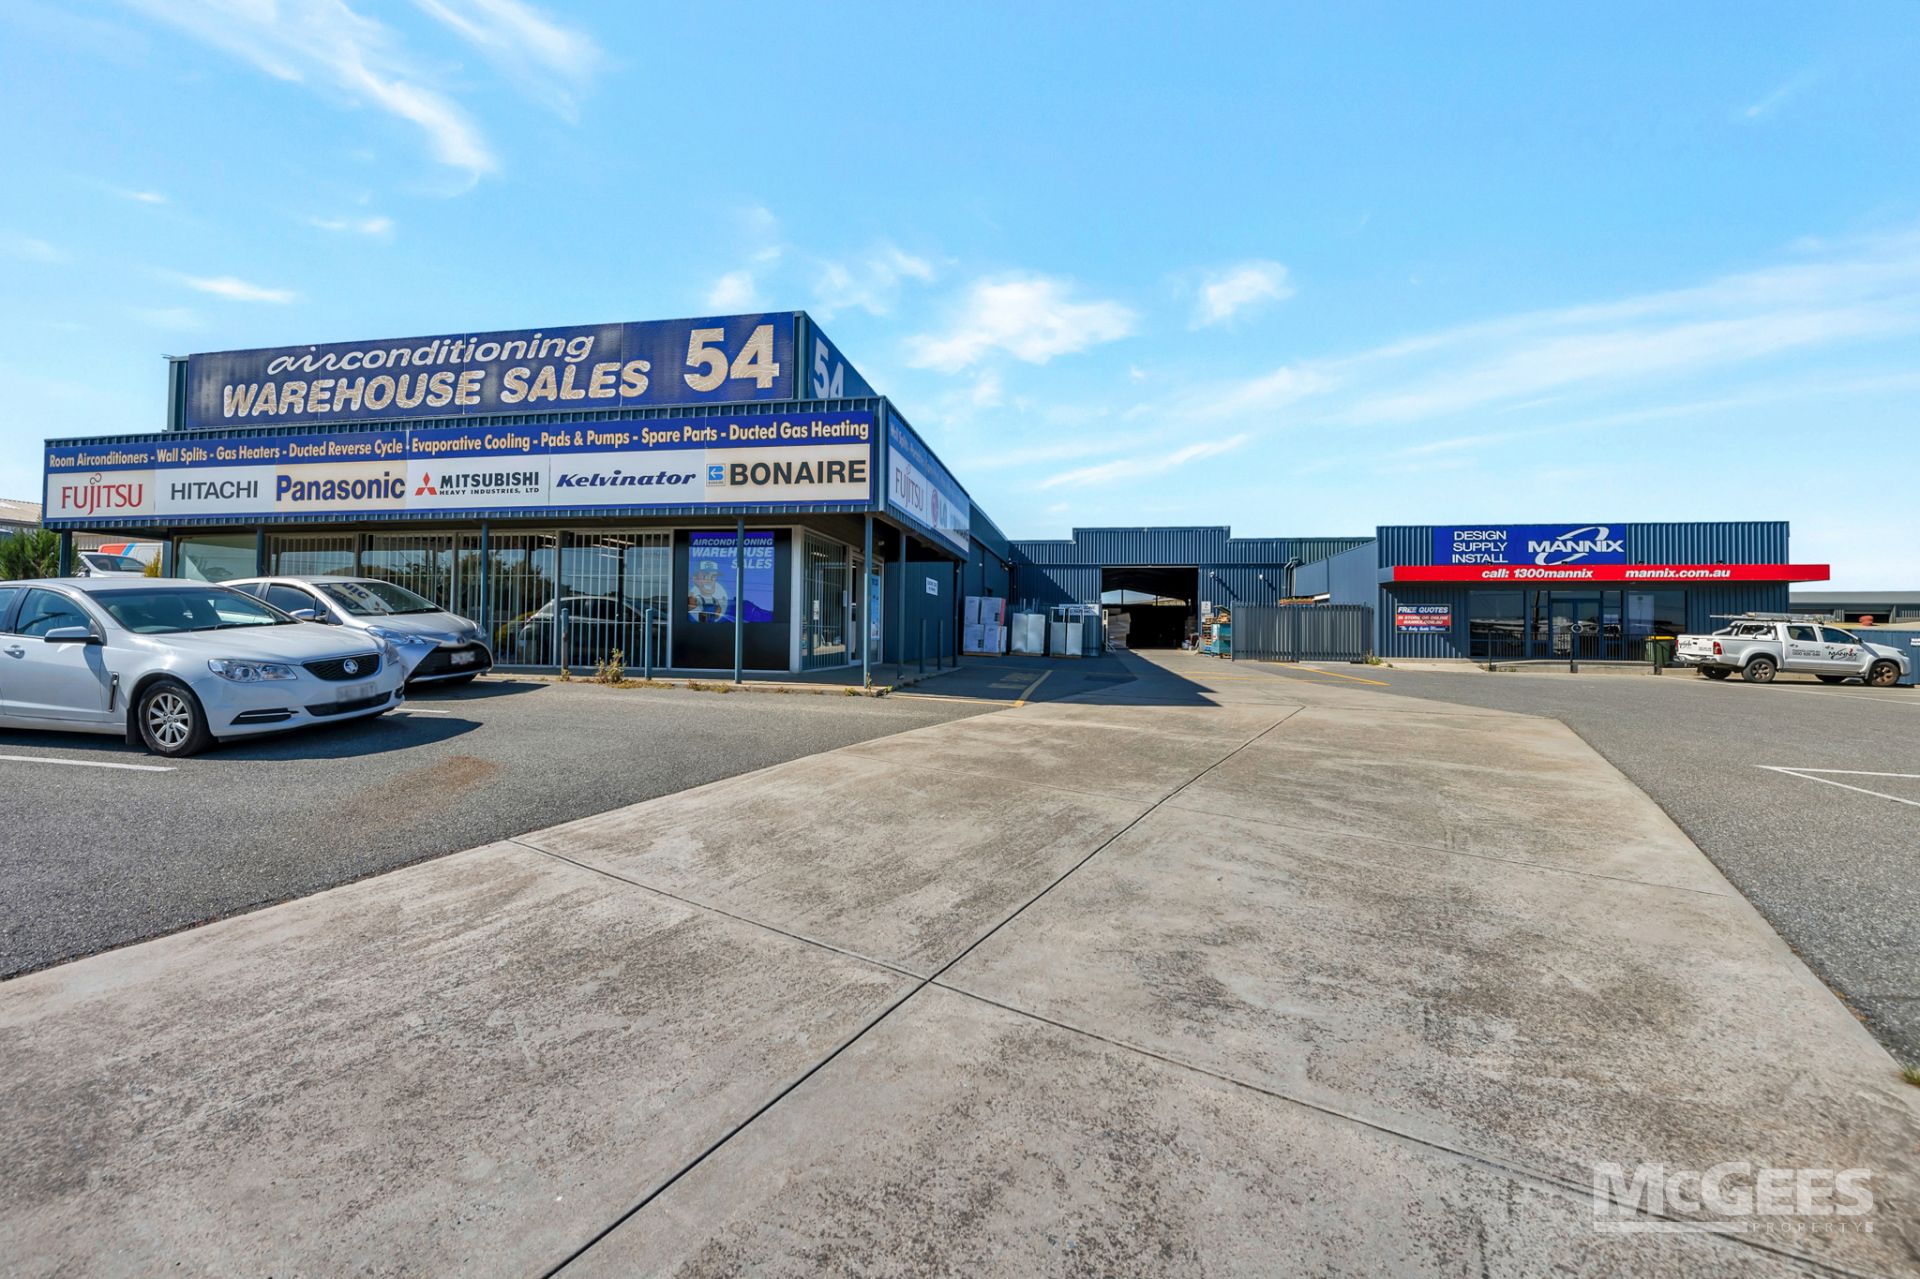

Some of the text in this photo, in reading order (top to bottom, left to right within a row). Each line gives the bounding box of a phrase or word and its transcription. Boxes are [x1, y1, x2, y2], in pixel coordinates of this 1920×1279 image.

[267, 333, 595, 375] airconditioning
[683, 324, 780, 392] 54
[814, 337, 844, 399] 54
[223, 360, 651, 418] WAREHOUSE SALES
[49, 454, 75, 468] Room
[77, 450, 148, 467] Airconditioners
[156, 447, 179, 463] Wall
[180, 446, 208, 465] Splits
[216, 446, 237, 460] Gas
[238, 445, 280, 459] Heaters
[289, 441, 326, 457] Ducted
[328, 442, 372, 456] Reverse
[374, 438, 403, 458] Cycle
[412, 435, 481, 456] Evaporative
[484, 432, 531, 452] Cooling
[540, 430, 571, 447] Pads
[574, 430, 584, 446] &
[586, 429, 630, 449] Pumps
[641, 427, 681, 447] Spare
[683, 425, 718, 442] Parts
[729, 421, 777, 441] Ducted
[780, 420, 808, 440] Gas
[811, 419, 869, 440] Heating
[440, 471, 539, 488] MITSUBISHI
[556, 470, 696, 488] Kelvinator
[730, 460, 867, 486] BONAIRE
[61, 473, 143, 515] FUJITSU
[171, 480, 258, 501] HITACHI
[276, 471, 406, 502] Panasonic
[896, 465, 924, 512] FUJITSU
[692, 538, 773, 546] AIRCONDIONING
[1453, 530, 1507, 541] DESIGN
[692, 547, 774, 558] WAREHUSE
[1453, 542, 1508, 552] SUPPLY
[1528, 540, 1624, 553] MANNIX
[731, 559, 772, 569] SLES
[1452, 553, 1509, 563] INSTALL
[1482, 568, 1731, 578] call: 1300mannix mannix.com.au
